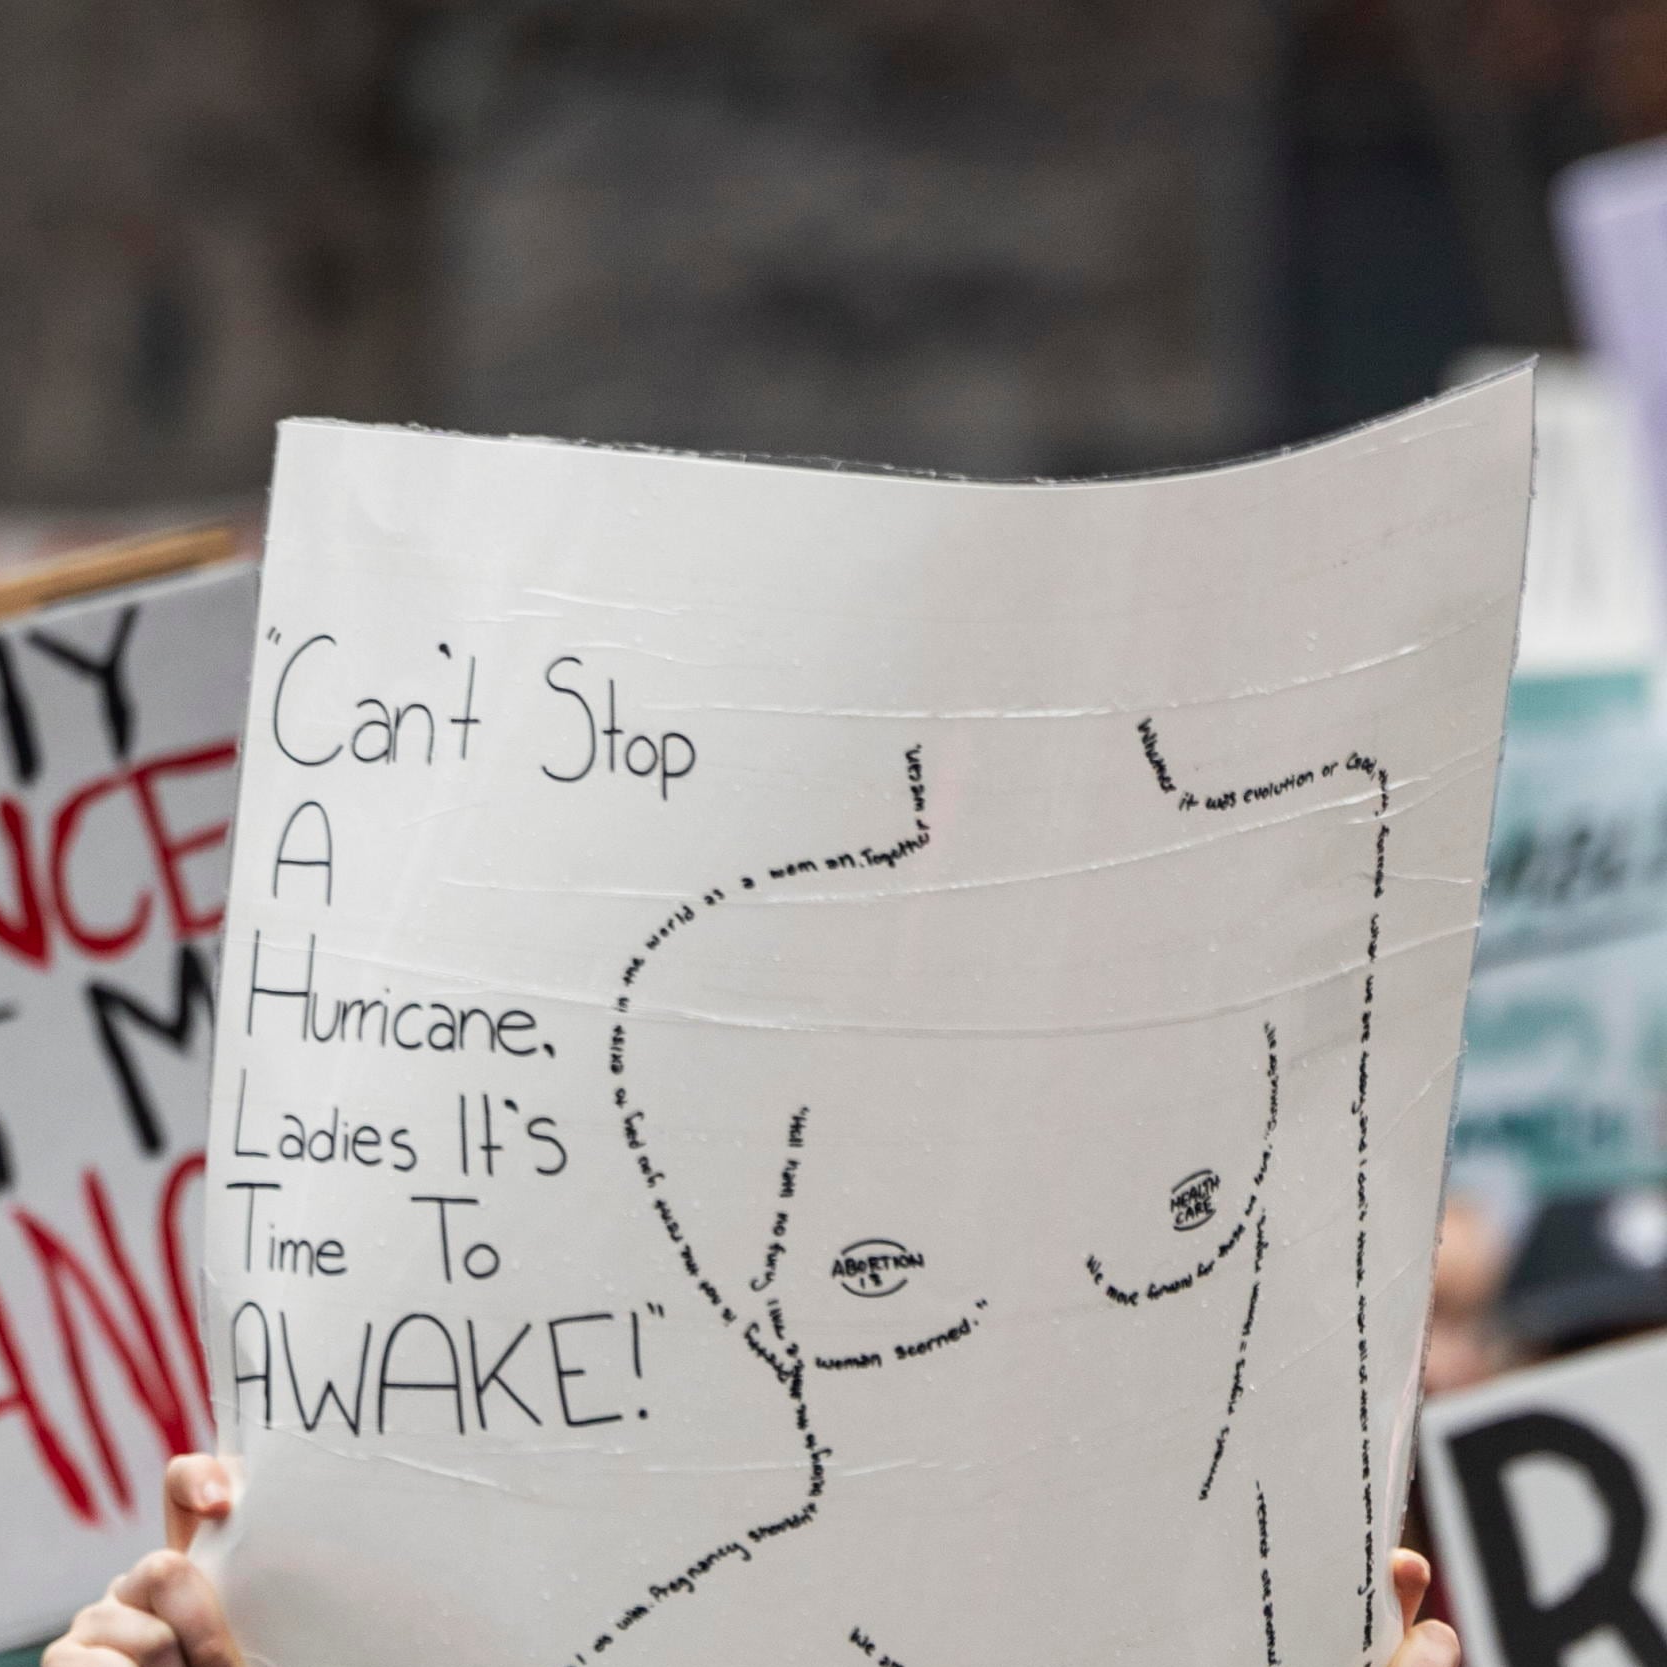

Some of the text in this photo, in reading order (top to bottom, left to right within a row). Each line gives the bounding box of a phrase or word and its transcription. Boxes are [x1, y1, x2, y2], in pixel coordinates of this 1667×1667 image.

[541, 656, 697, 801] Stop
[1242, 769, 1315, 805] evolution
[1321, 761, 1339, 778] or
[272, 801, 334, 907] A
[702, 888, 726, 907] as
[740, 875, 756, 891] a
[644, 904, 697, 951] world
[622, 956, 646, 987] the
[616, 996, 630, 1014] in
[609, 1024, 626, 1076] exist
[614, 1087, 627, 1110] to
[234, 1068, 420, 1173] Ladies
[623, 1109, 645, 1149] pay
[637, 1155, 665, 1188] you
[1169, 1175, 1220, 1212] HEALTH
[772, 1211, 788, 1237] no
[1175, 1200, 1214, 1225] CARE
[226, 1181, 502, 1285] Time To
[750, 1242, 786, 1292] fury
[831, 1252, 926, 1278] ABORTION
